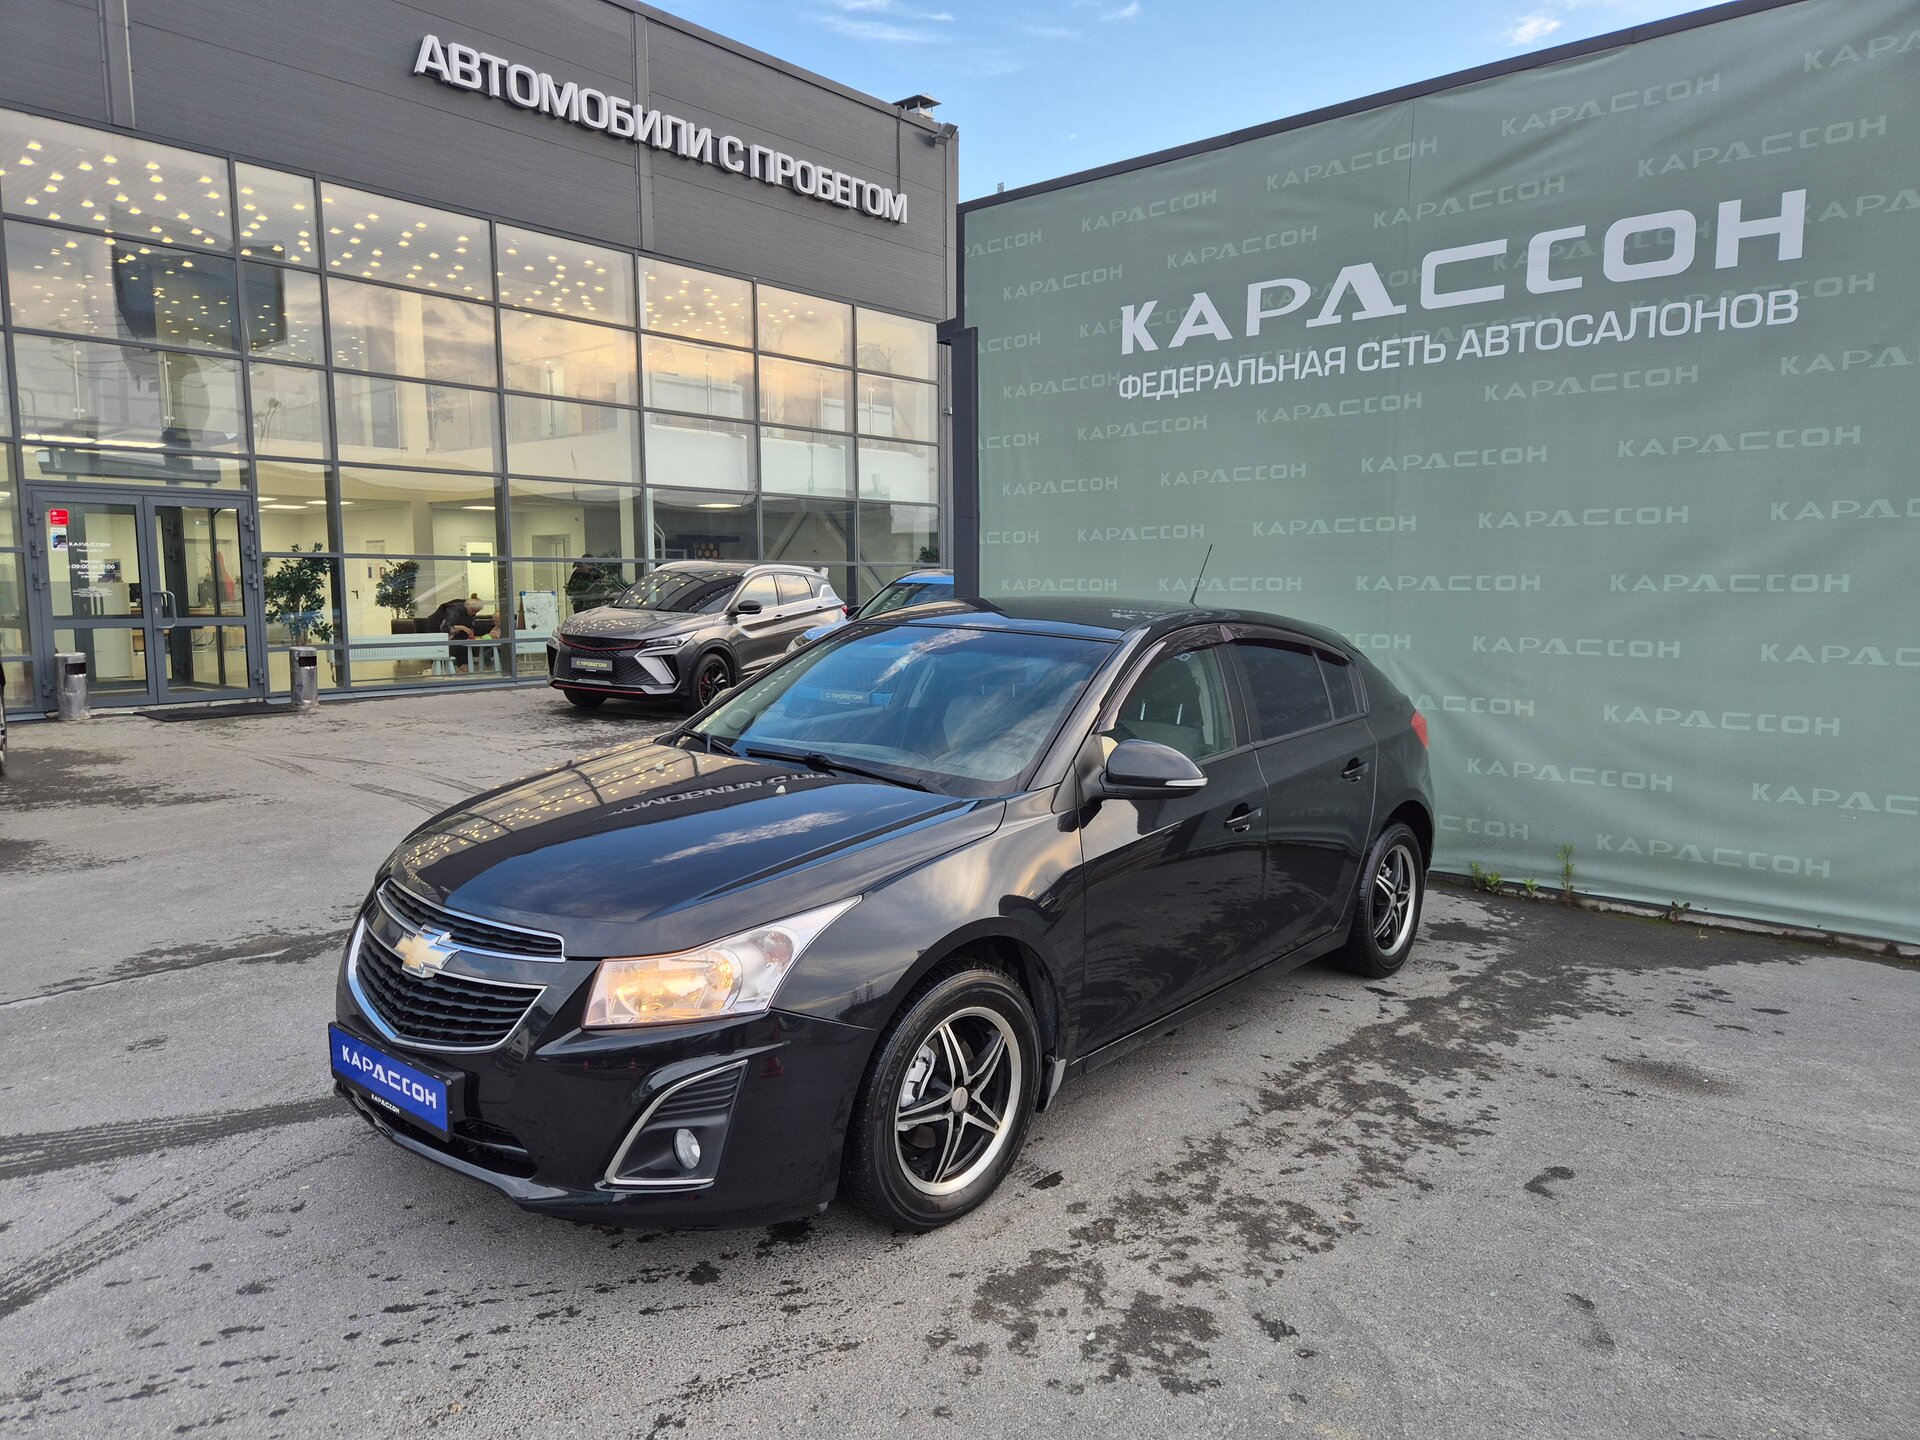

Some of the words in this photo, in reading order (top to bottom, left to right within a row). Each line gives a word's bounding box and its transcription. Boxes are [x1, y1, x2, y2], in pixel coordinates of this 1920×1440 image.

[1501, 72, 1721, 137] КАРАССОН
[415, 34, 713, 165] АВТОМОБИЛИ
[718, 135, 745, 173] С
[750, 143, 909, 225] ПРОБЕГОМ
[1638, 114, 1888, 178] КАРАССОН
[1266, 135, 1438, 192] КАРАССОН
[1081, 188, 1218, 233] КАРАССОН
[1373, 174, 1567, 230] КАРАССОН
[1167, 224, 1318, 270] КАРАССОН
[1003, 264, 1124, 301] КАРАССОН
[1121, 188, 1807, 356] КАРАССОН
[1119, 345, 1347, 401] ФЕДЕРАЛЬНАЯ
[1356, 334, 1446, 372] СЕТЬ
[1456, 288, 1800, 361] АВТОСАЛОНОВ
[1002, 371, 1122, 400] КАРАССОН
[1484, 364, 1700, 403] КАРАССОН
[1255, 391, 1423, 425] КАРАССОН
[1078, 414, 1209, 442] КАРАССОН
[1617, 424, 1862, 459] КАРАССОН
[1160, 462, 1307, 487] КАРАССОН
[1361, 445, 1548, 475] КАРАССОН
[1002, 476, 1118, 497] КАРАССОН
[1077, 524, 1206, 543] КАРАССОН
[1252, 515, 1418, 538] КАРАССОН
[1478, 505, 1690, 530] КАРАССОН
[1001, 577, 1118, 592] КАРАССОН
[1355, 574, 1542, 593] КАРАССОН
[1610, 573, 1851, 594] КАРАССОН
[1472, 634, 1681, 659] КАРАССОН
[1603, 704, 1840, 737] КАРАССОН
[1467, 756, 1674, 793] КАРАССОН
[1597, 832, 1831, 879] КАРАССОН
[341, 1044, 438, 1110] КАРАССОН
